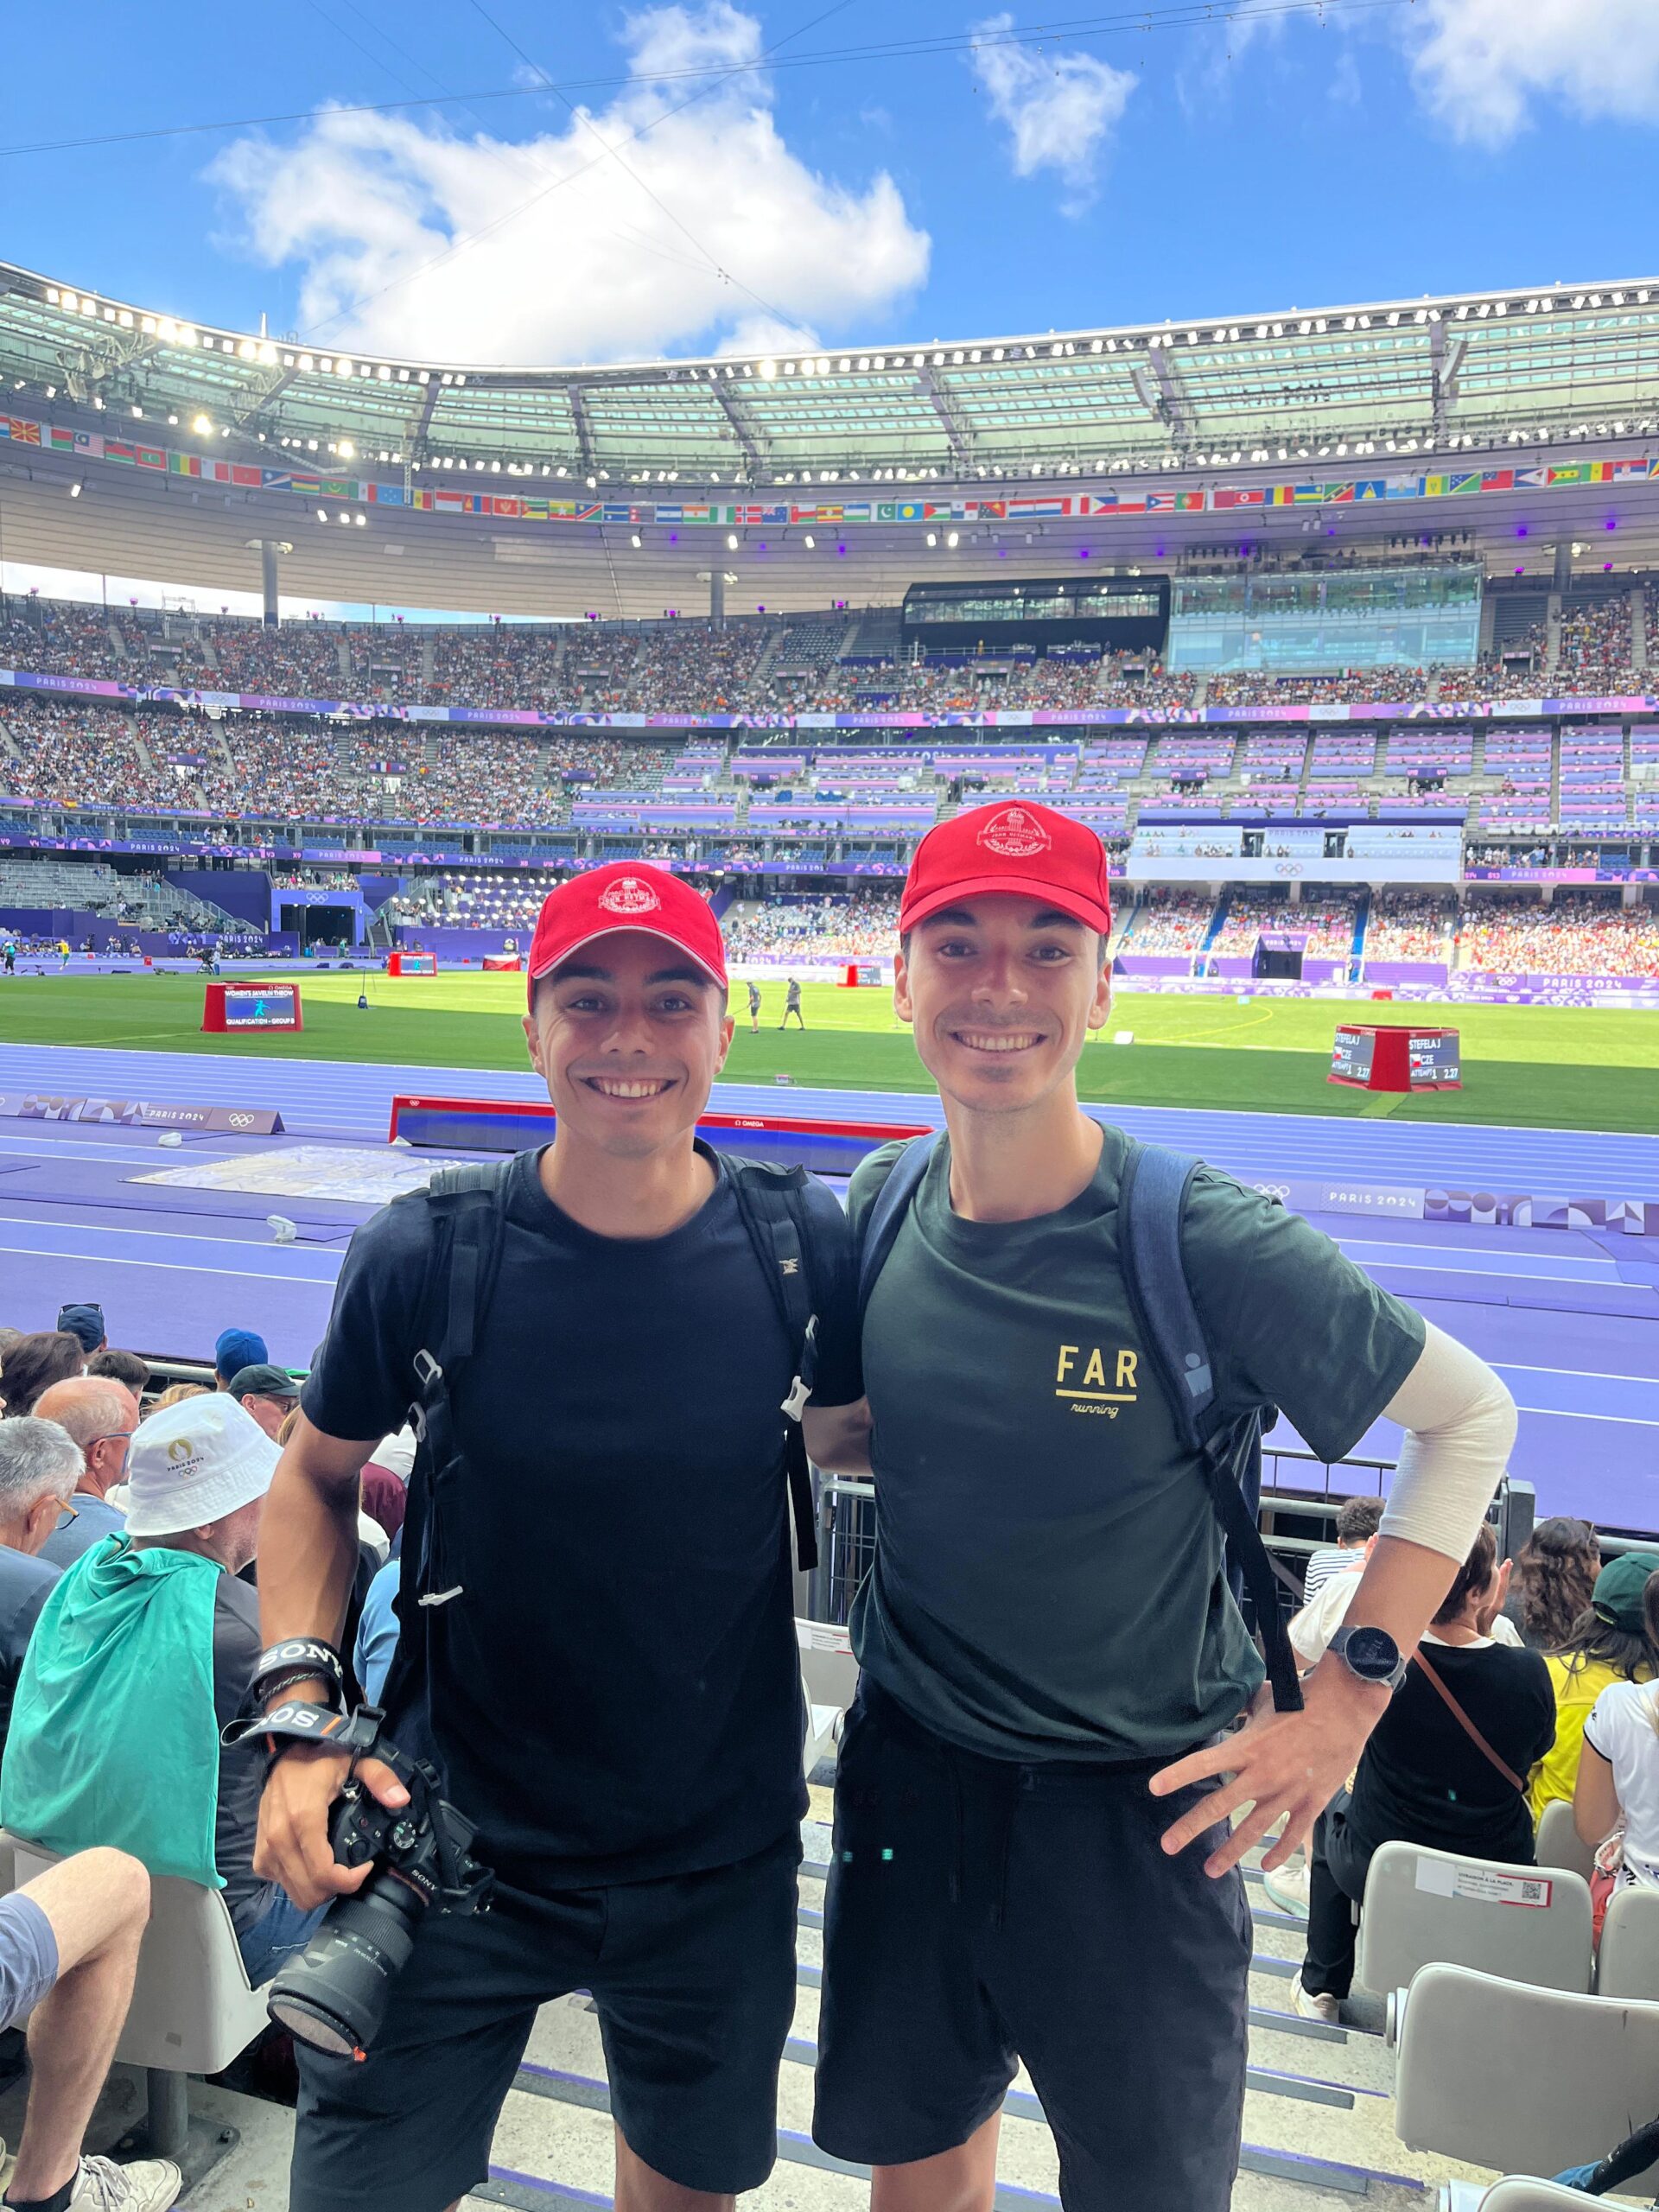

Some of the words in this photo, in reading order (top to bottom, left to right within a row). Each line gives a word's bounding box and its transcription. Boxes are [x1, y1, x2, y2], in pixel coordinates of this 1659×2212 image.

[36, 677, 67, 688] PARIS
[70, 680, 98, 690] 2024
[260, 699, 288, 708] PARIS
[290, 701, 316, 710] 2024
[1560, 702, 1592, 710] PARIS
[1596, 700, 1626, 709] 2024
[467, 711, 493, 720] PARIS
[496, 712, 520, 721] 2024
[1051, 713, 1078, 721] PARIS
[1228, 709, 1256, 718] PARIS
[130, 842, 155, 851] PARIS
[158, 844, 180, 853] 2024
[1511, 870, 1539, 879] PARIS
[1542, 870, 1567, 879] 2024
[219, 935, 242, 944] PARIS
[244, 935, 263, 944] 2024
[1542, 977, 1582, 988] PARIS
[1585, 978, 1623, 988] 2024
[1408, 1039, 1436, 1050] STEFELA
[1342, 1049, 1352, 1060] CZE
[1421, 1054, 1434, 1065] CZE
[1357, 1066, 1370, 1078] 2.27
[1443, 1068, 1459, 1079] 2.27
[149, 1109, 177, 1120] PARIS
[179, 1112, 204, 1122] 2024
[1330, 1192, 1372, 1205] PARIS
[1377, 1195, 1416, 1207] 2024
[1057, 1344, 1138, 1388] FAR
[1071, 1403, 1119, 1419] running
[167, 1462, 186, 1471] PARIS
[187, 1457, 204, 1465] 2024
[258, 1643, 343, 1679] SONY
[411, 1869, 437, 1891] SONY
[1458, 1872, 1484, 1881] LIVRAISON
